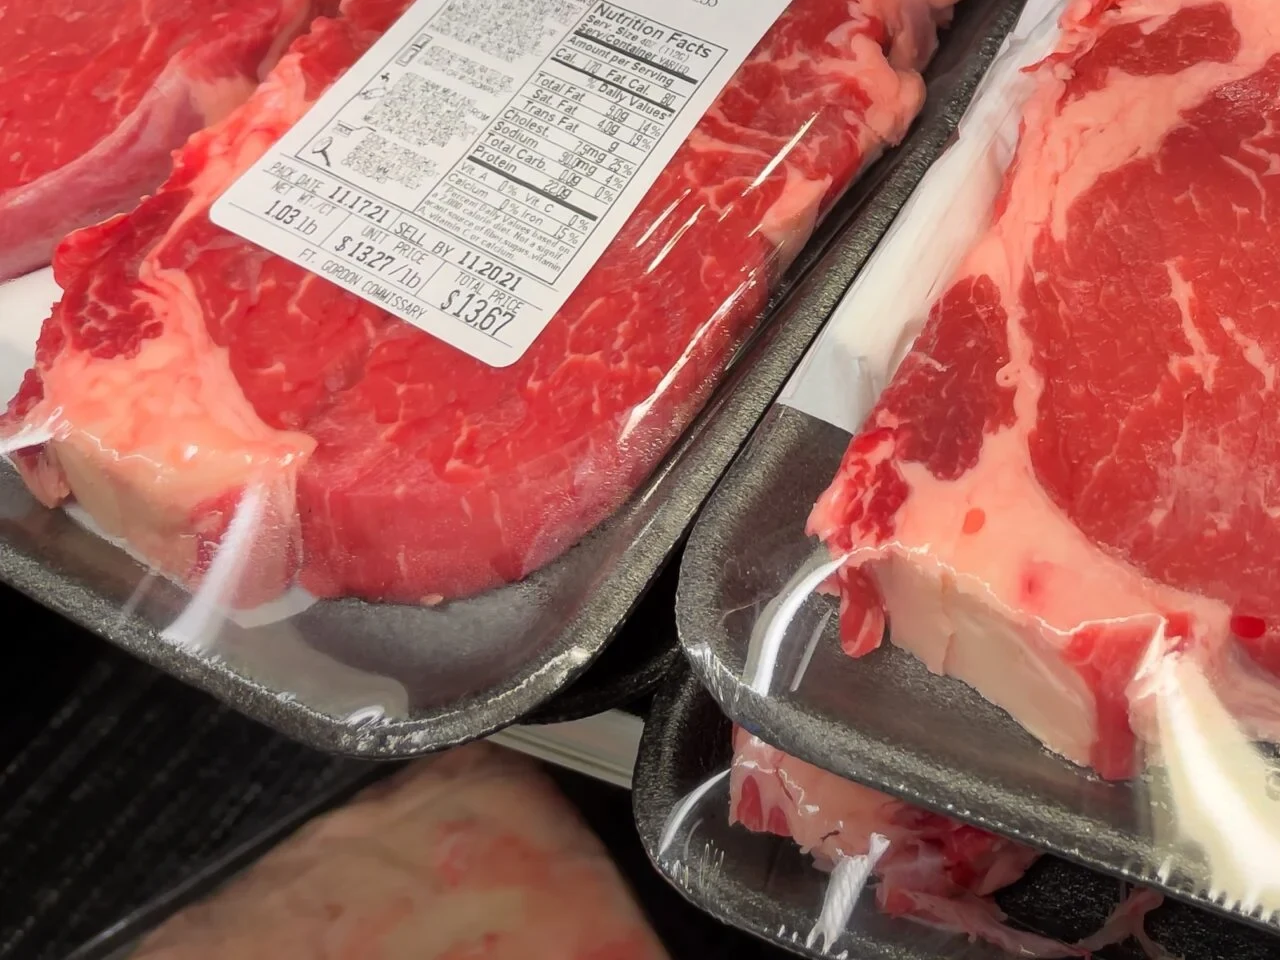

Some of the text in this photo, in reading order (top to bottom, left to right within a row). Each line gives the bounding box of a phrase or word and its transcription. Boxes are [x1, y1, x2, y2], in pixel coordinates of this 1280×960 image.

[576, 22, 657, 62] Serv/Container
[585, 14, 639, 42] Serv. Size
[593, 2, 712, 58] Nutrition Facts
[567, 36, 675, 89] Amount per Serving
[534, 72, 586, 102] Total Fat
[597, 82, 628, 105] Daily
[605, 68, 651, 96] Fat Cal.
[522, 99, 579, 133] Trans Fat
[531, 88, 578, 116] Sat. Fat
[493, 120, 539, 148] Sodium
[503, 108, 549, 137] Cholest.
[472, 144, 517, 173] Protein
[483, 131, 546, 171] Total Carb.
[271, 179, 295, 195] NET
[294, 173, 324, 195] DATE
[328, 185, 390, 223] 11.17.21
[264, 199, 318, 236] 1.03 lb
[360, 225, 429, 265] UNIT PRICE
[392, 221, 522, 291] SELL BY 11.20.21
[297, 247, 427, 319] FT. GORDON COMMISSARY
[454, 270, 524, 314] TOTAL PRICE
[440, 289, 515, 336] $13.67
